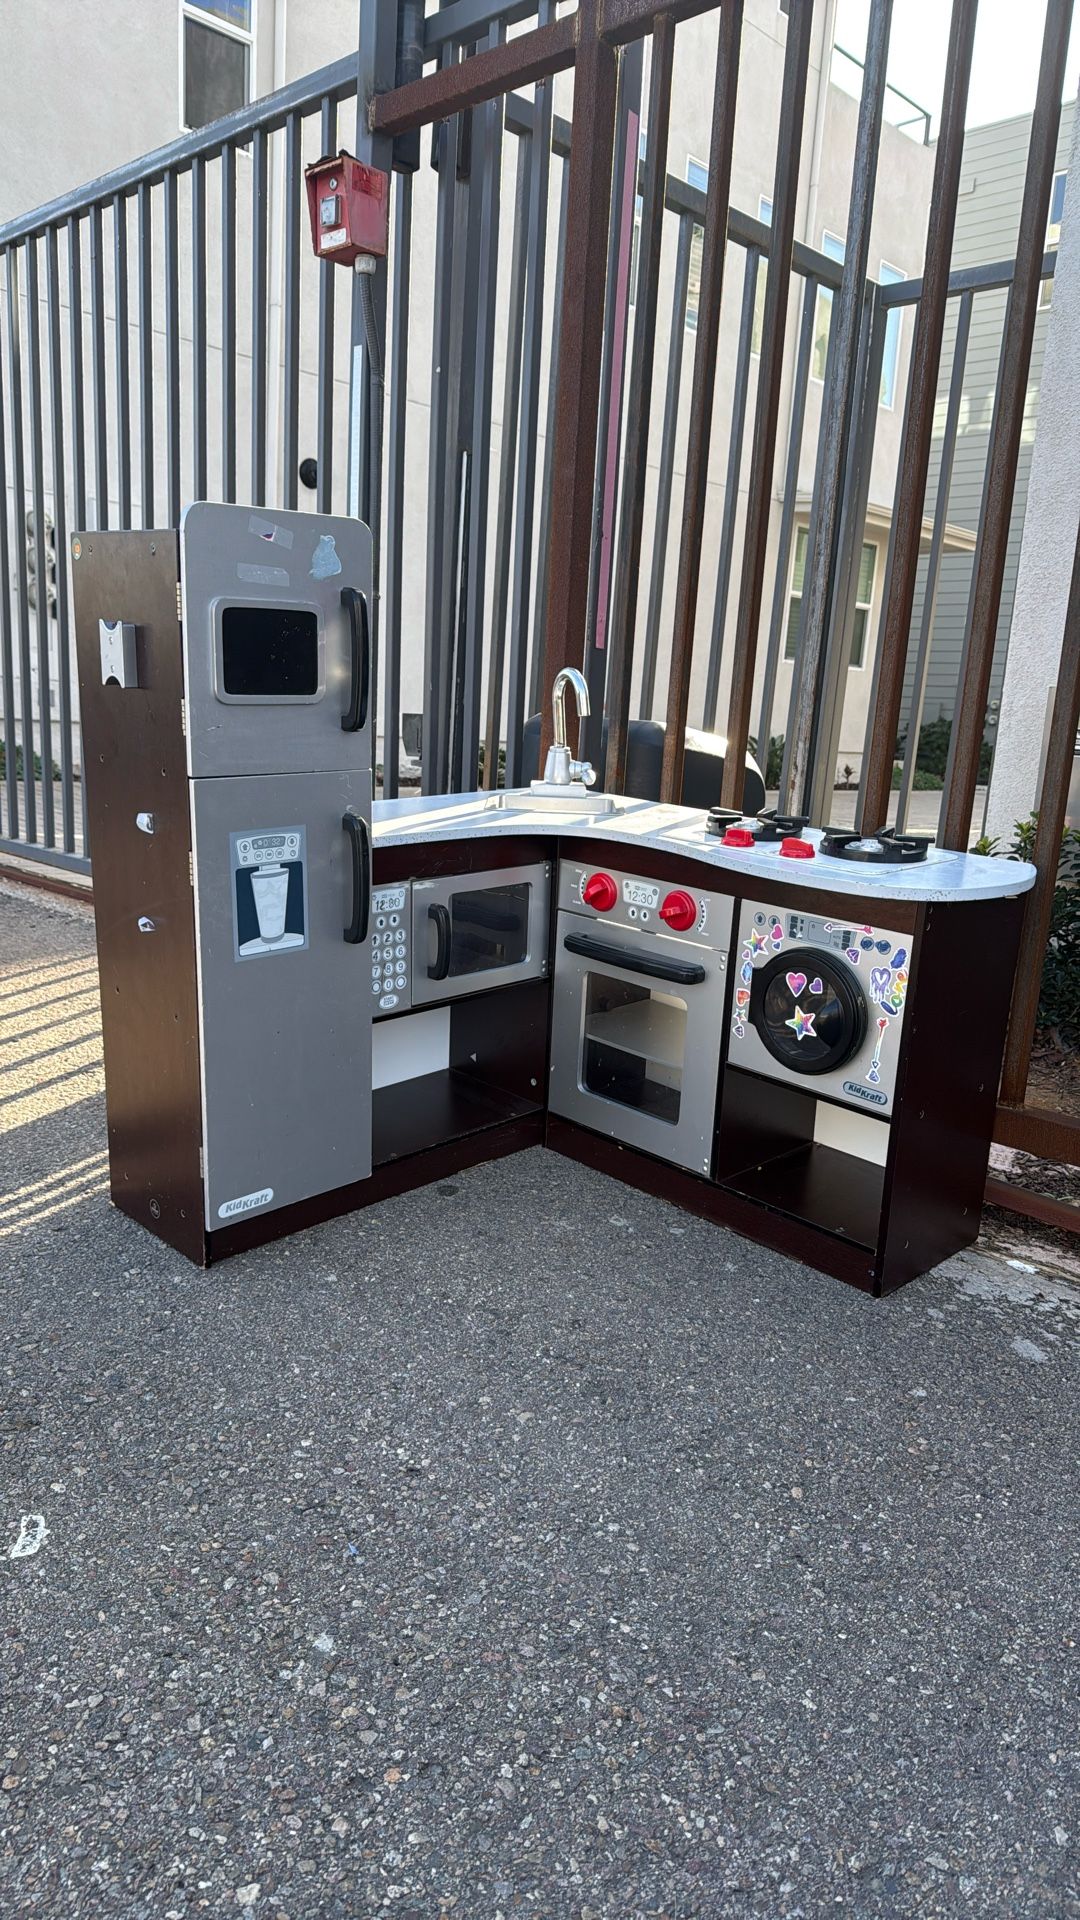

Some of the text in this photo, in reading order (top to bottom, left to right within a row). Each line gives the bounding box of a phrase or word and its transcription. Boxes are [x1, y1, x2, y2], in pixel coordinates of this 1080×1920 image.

[628, 890, 653, 905] 12:30
[385, 933, 391, 943] 2
[398, 931, 403, 941] 3
[372, 946, 403, 962] 4 5 6
[373, 962, 403, 977] 7 8 9
[848, 1084, 883, 1103] KidKraft
[225, 1193, 269, 1213] KidKraft
